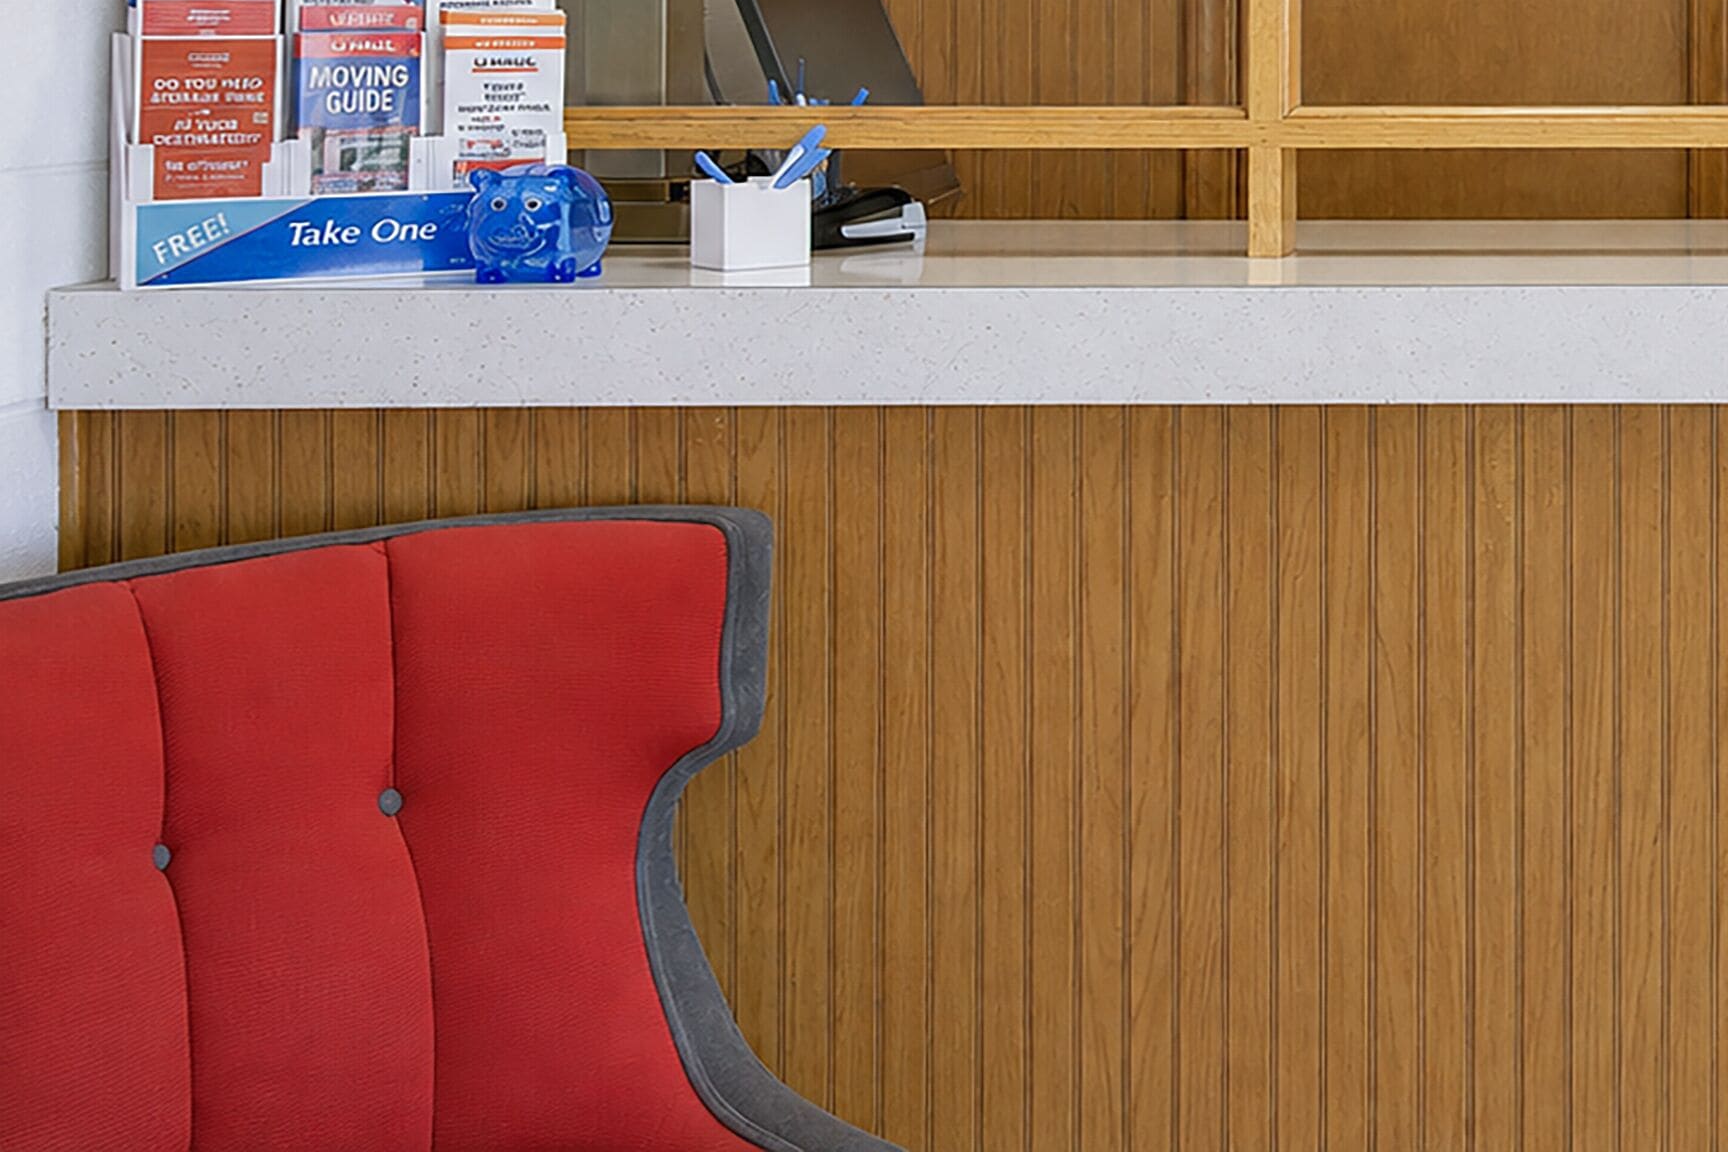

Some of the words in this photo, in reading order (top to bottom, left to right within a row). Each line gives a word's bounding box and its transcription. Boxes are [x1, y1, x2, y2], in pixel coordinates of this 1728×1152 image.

[309, 65, 409, 89] MOVING
[326, 89, 394, 114] GUIDE
[151, 211, 230, 265] FREE!
[288, 219, 361, 247] Take
[371, 218, 438, 242] One
